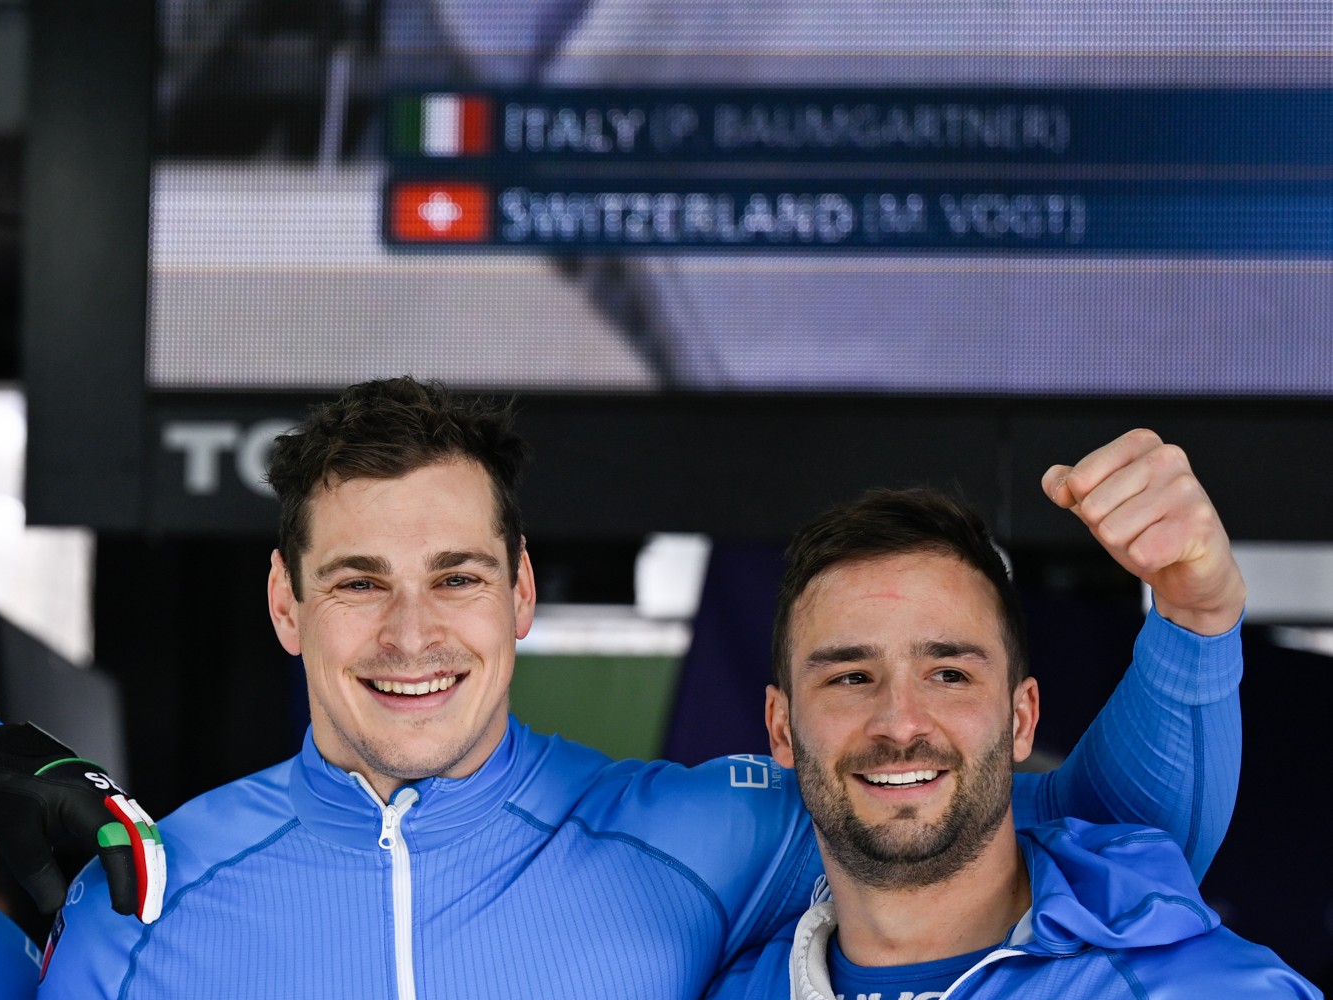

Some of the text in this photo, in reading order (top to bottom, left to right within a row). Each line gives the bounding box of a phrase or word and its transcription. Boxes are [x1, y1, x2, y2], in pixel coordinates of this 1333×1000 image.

[504, 103, 645, 152] ITALY
[497, 187, 854, 243] SWITZERLAND
[728, 753, 769, 789] EA
